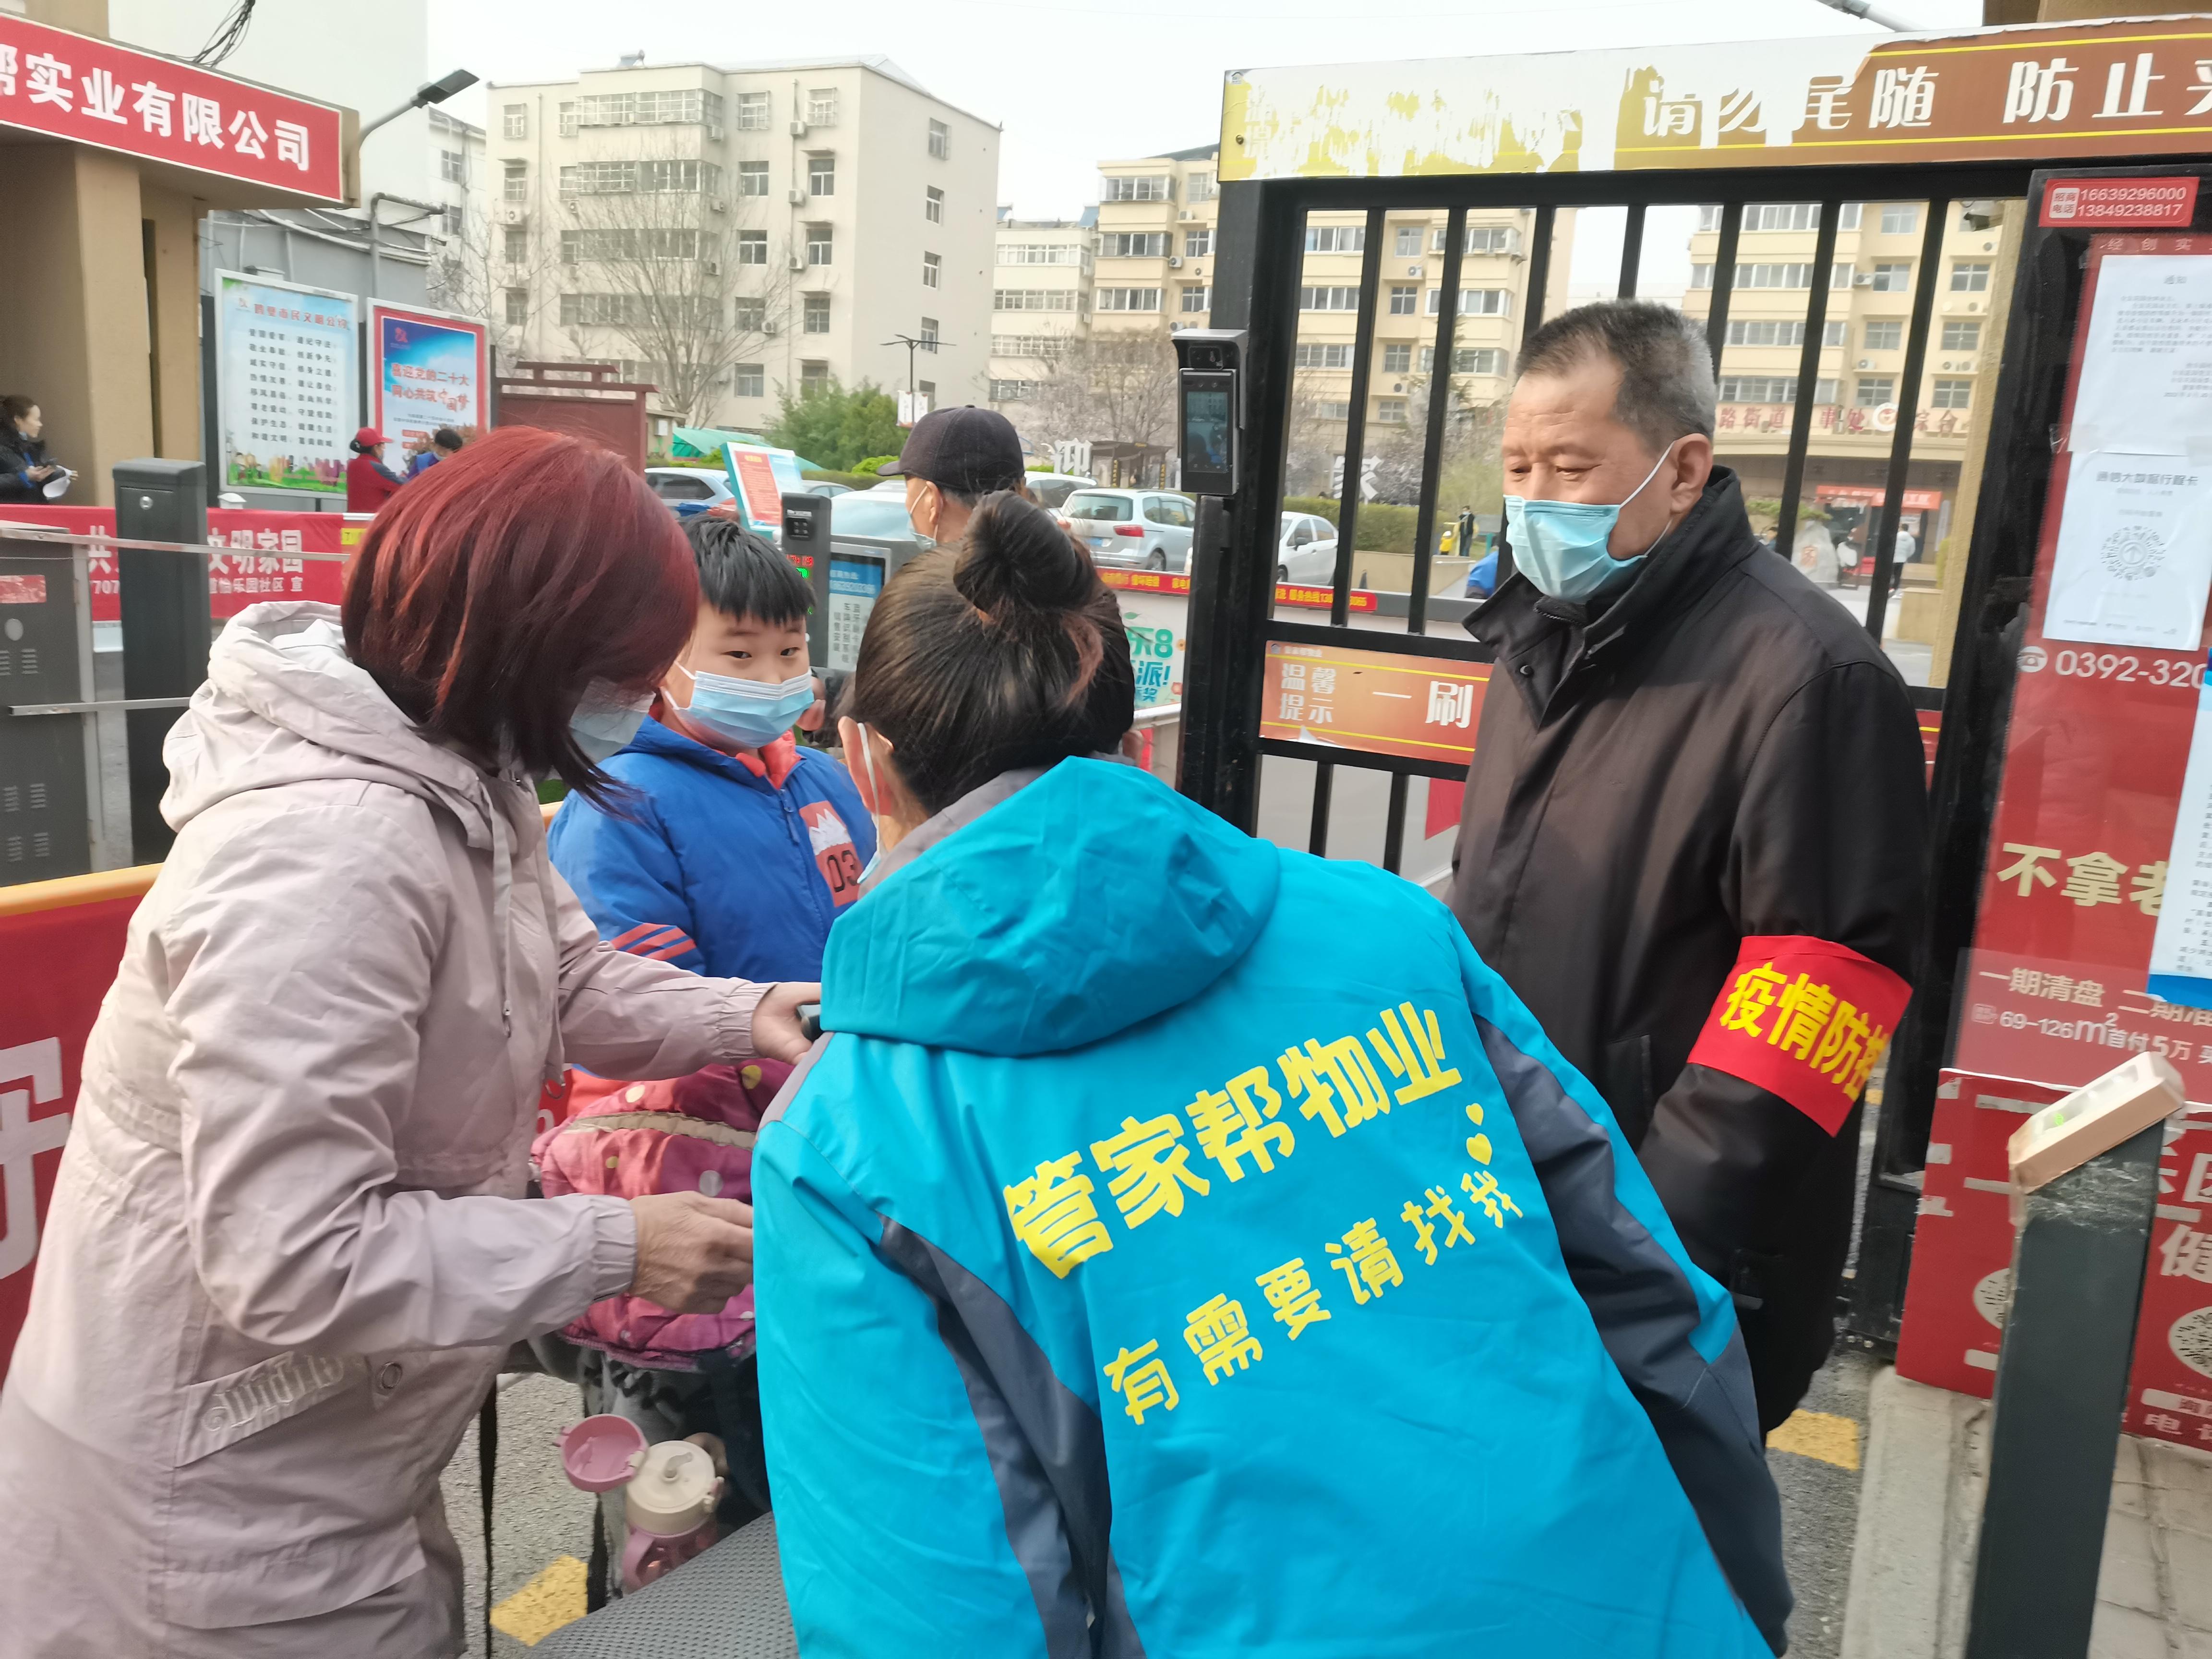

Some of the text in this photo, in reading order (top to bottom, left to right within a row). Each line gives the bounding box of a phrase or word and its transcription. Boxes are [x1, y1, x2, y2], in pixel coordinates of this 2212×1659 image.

[2052, 204, 2076, 214] 电话
[2080, 187, 2187, 201] 16639296000
[2077, 204, 2184, 216] 13849238817
[391, 362, 470, 386] 喜迎党的二十大
[391, 385, 470, 412] 同心共筑中国梦
[207, 527, 303, 575] 文明家园
[1131, 660, 1170, 687] 派!
[1281, 663, 1336, 694] 温馨
[1279, 693, 1334, 724] 提示
[826, 850, 860, 893] 03
[1979, 967, 2106, 1008] 一期清盘
[1003, 1001, 1462, 1280] 管家帮物业
[1103, 1170, 1523, 1425] 有需要请找我
